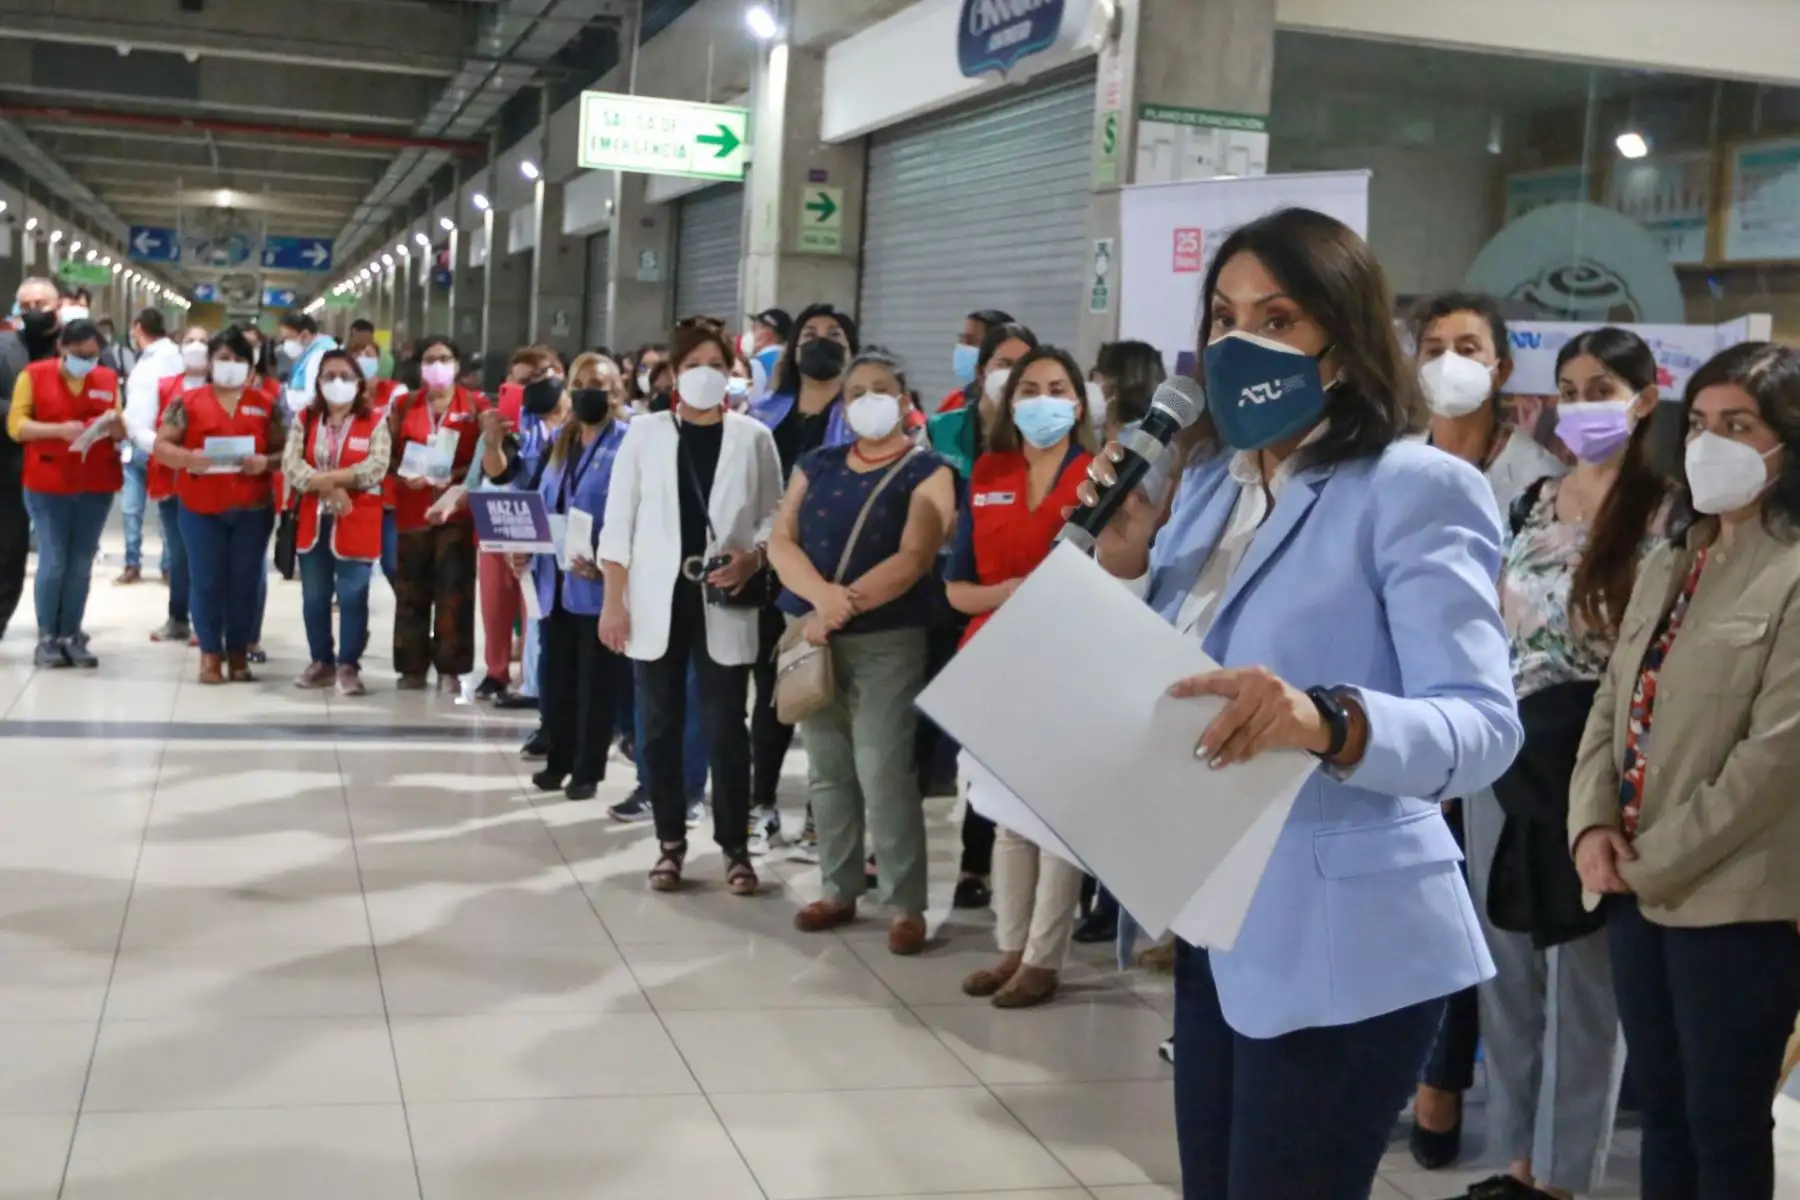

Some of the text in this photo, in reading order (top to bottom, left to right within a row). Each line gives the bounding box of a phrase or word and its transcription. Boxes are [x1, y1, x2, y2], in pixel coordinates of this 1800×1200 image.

[1177, 230, 1198, 253] 25
[1238, 379, 1282, 407] ATU
[486, 500, 532, 515] HAZ LA
